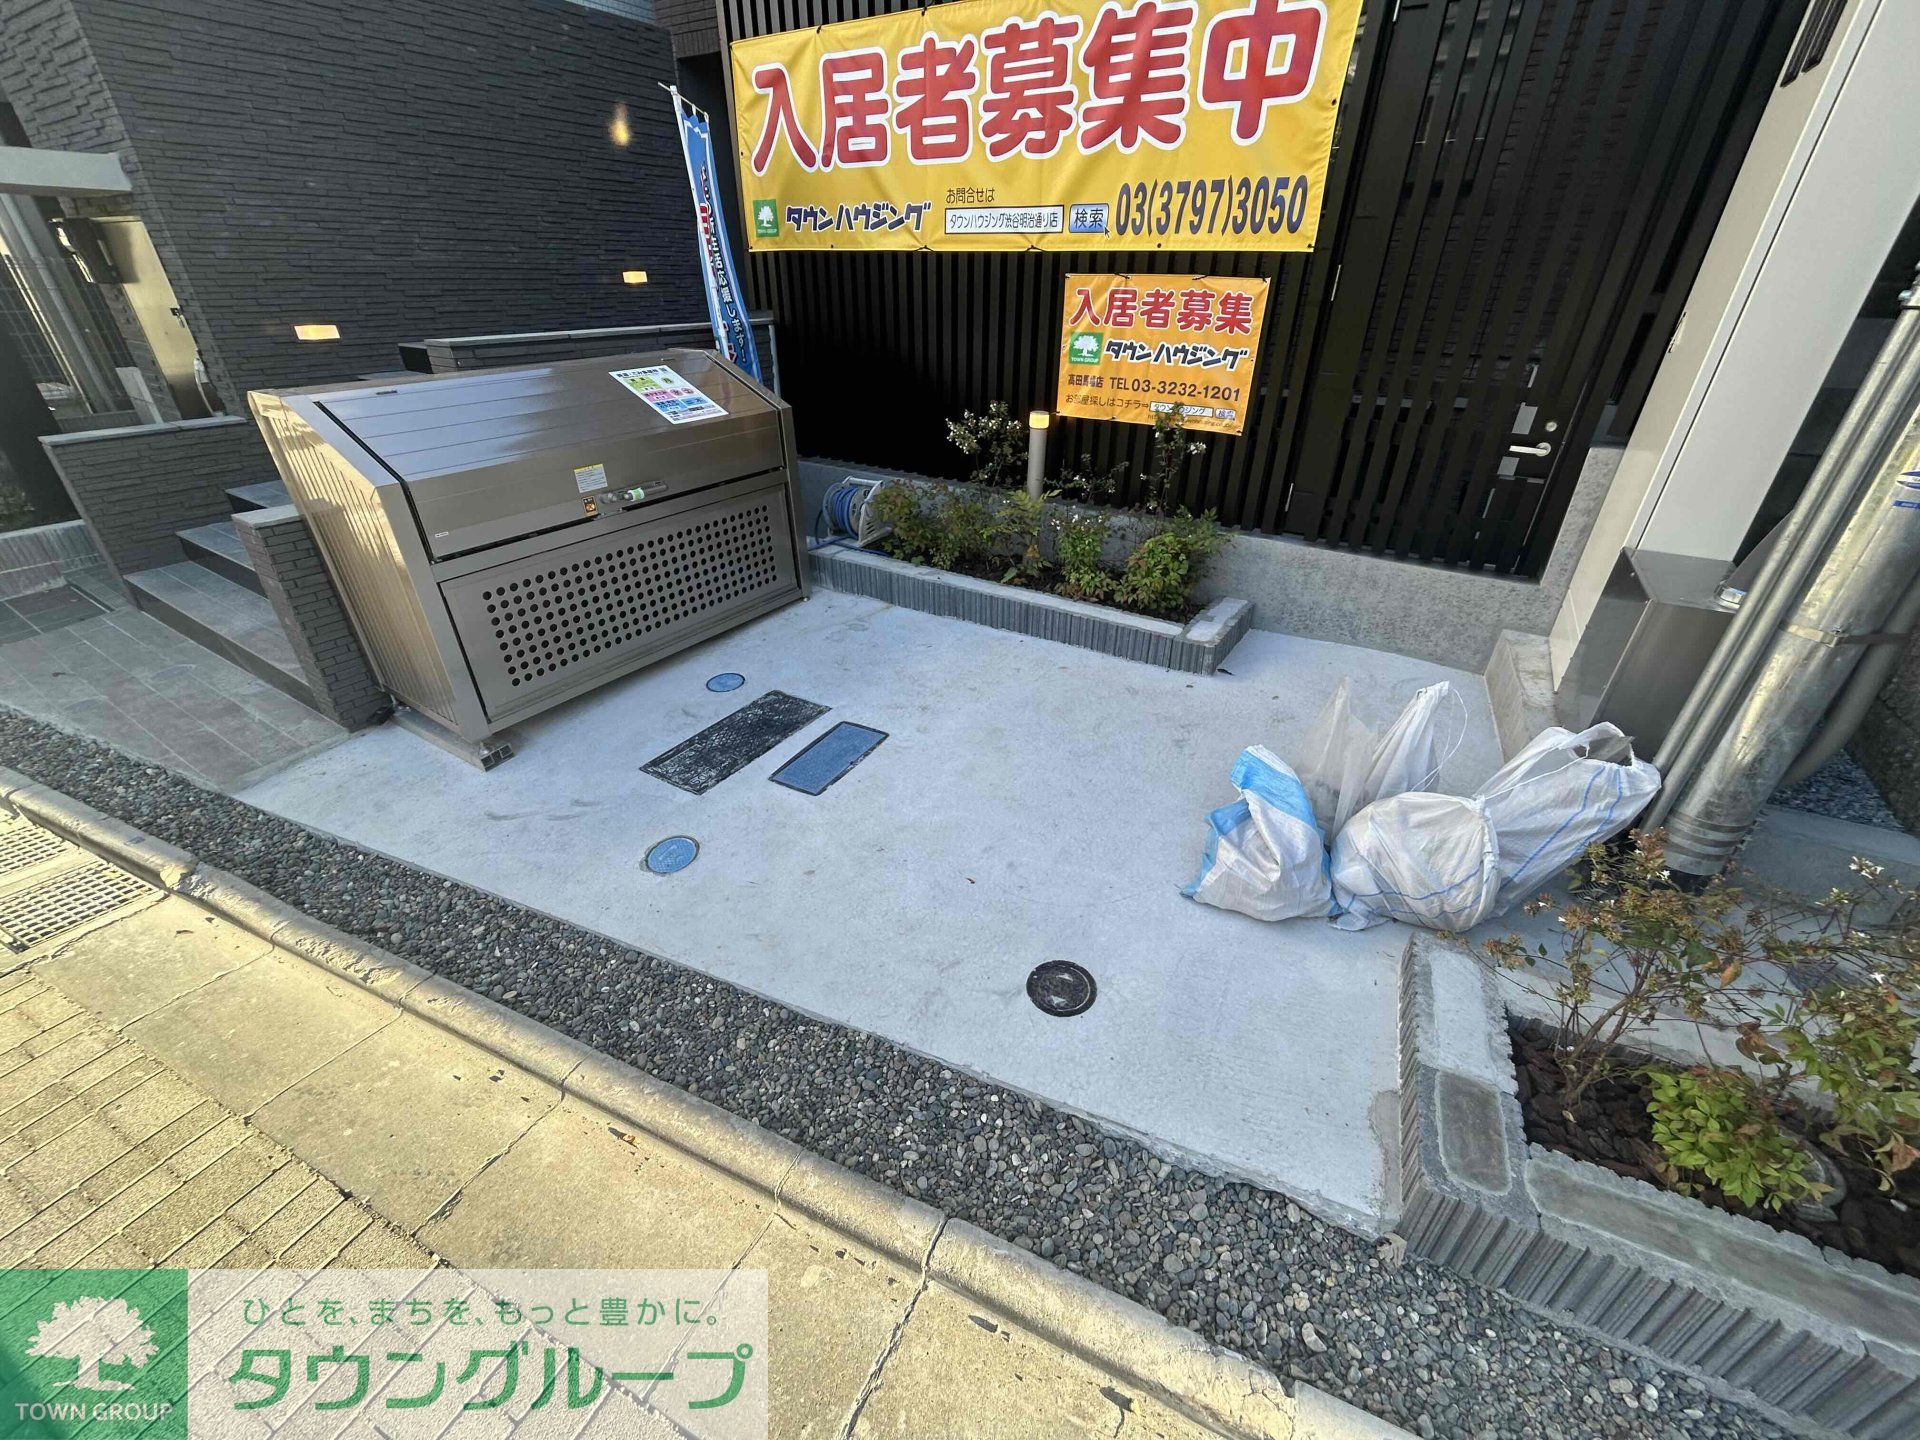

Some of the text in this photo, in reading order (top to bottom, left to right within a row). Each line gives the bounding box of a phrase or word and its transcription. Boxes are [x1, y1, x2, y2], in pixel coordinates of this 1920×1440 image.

[752, 0, 1326, 174] 入居者募集中
[945, 187, 996, 204] お問合せは
[1115, 174, 1309, 237] 03(3797)3050
[785, 201, 932, 232] タウンハウジング
[950, 211, 1059, 230] タウンハウジング渋谷明治通り店
[1073, 208, 1105, 229] 検索
[1069, 287, 1254, 335] 入居者募集
[1105, 339, 1249, 372] タウンハウジング
[1109, 377, 1129, 391] TEL
[1131, 378, 1240, 401] 03-3232-1201
[1154, 403, 1206, 415] タウンウジング
